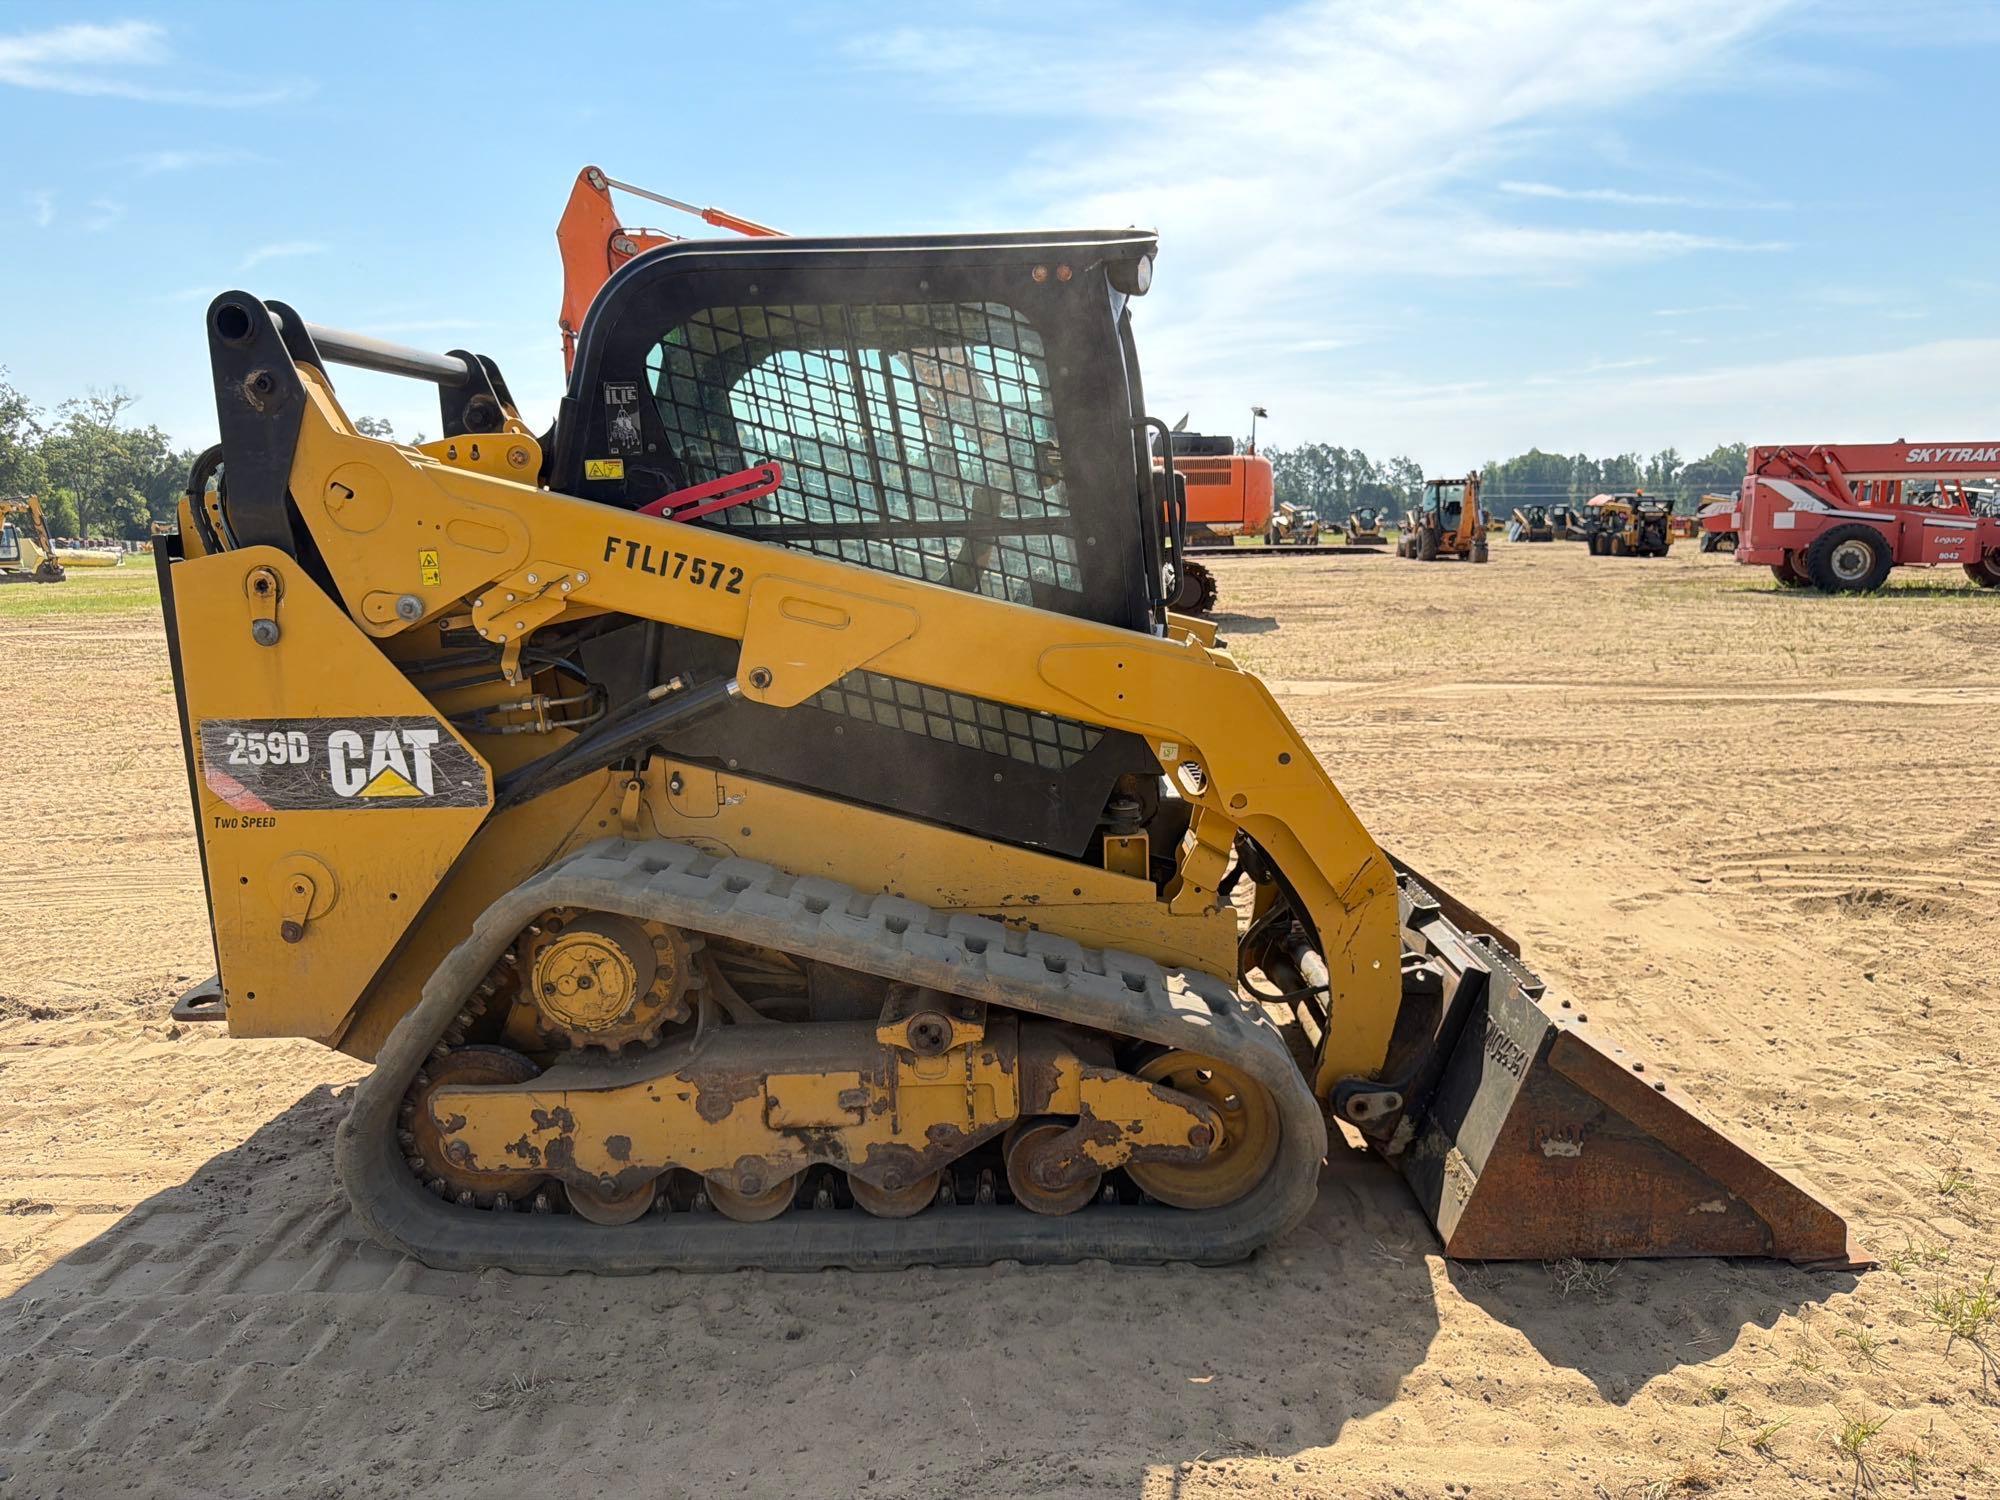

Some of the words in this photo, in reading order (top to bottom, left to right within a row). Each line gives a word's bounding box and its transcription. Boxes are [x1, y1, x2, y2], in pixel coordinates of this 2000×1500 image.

[1906, 448, 2000, 463] SKYTRAK
[1934, 536, 1965, 544] Legacy
[226, 731, 310, 765] 259D
[328, 729, 439, 798] CAT
